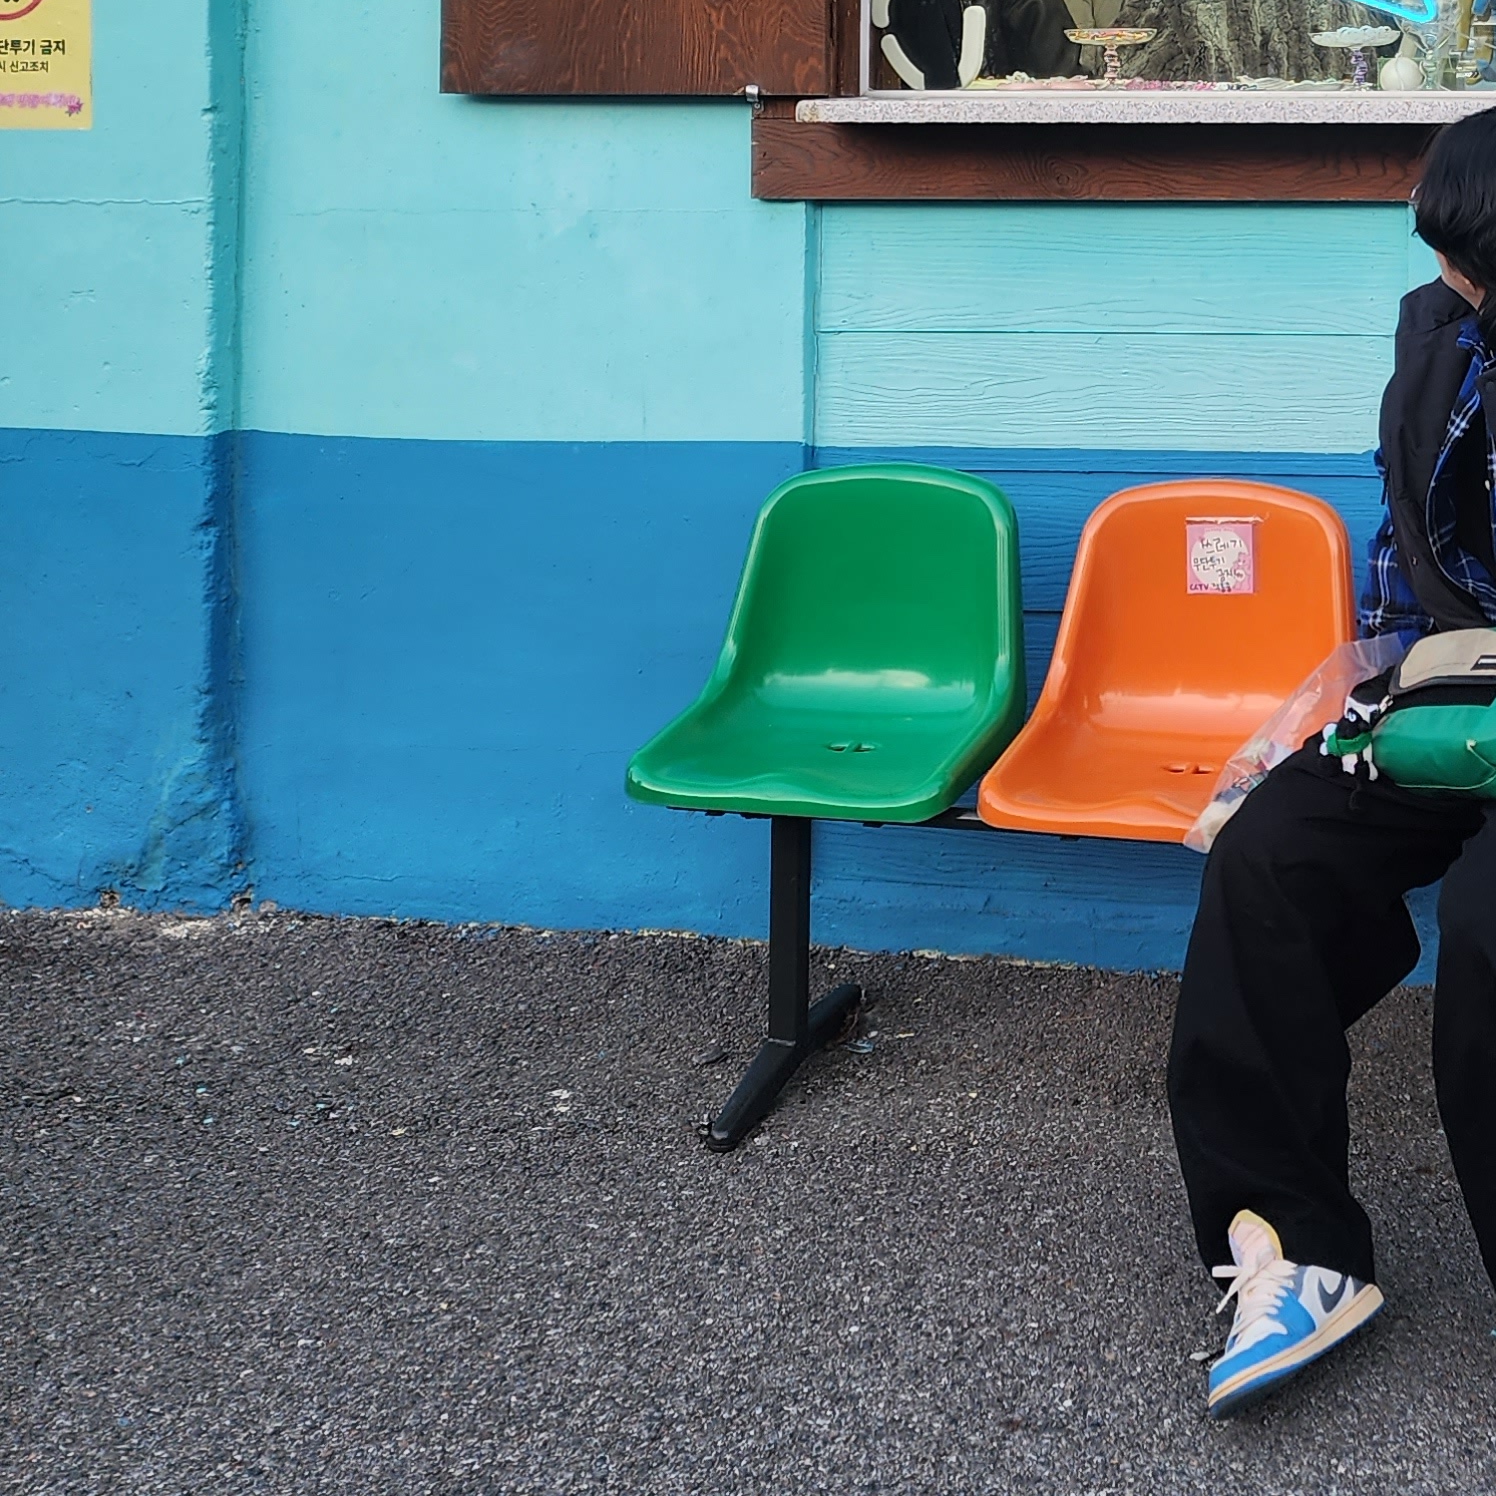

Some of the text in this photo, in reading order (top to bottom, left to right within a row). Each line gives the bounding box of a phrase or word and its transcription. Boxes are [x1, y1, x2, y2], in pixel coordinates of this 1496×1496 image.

[39, 39, 66, 55] 금지
[9, 60, 49, 73] 신고조치
[1200, 537, 1242, 554] 쓰레기
[1193, 556, 1225, 571] 무단투기
[1189, 583, 1209, 591] CCTV
